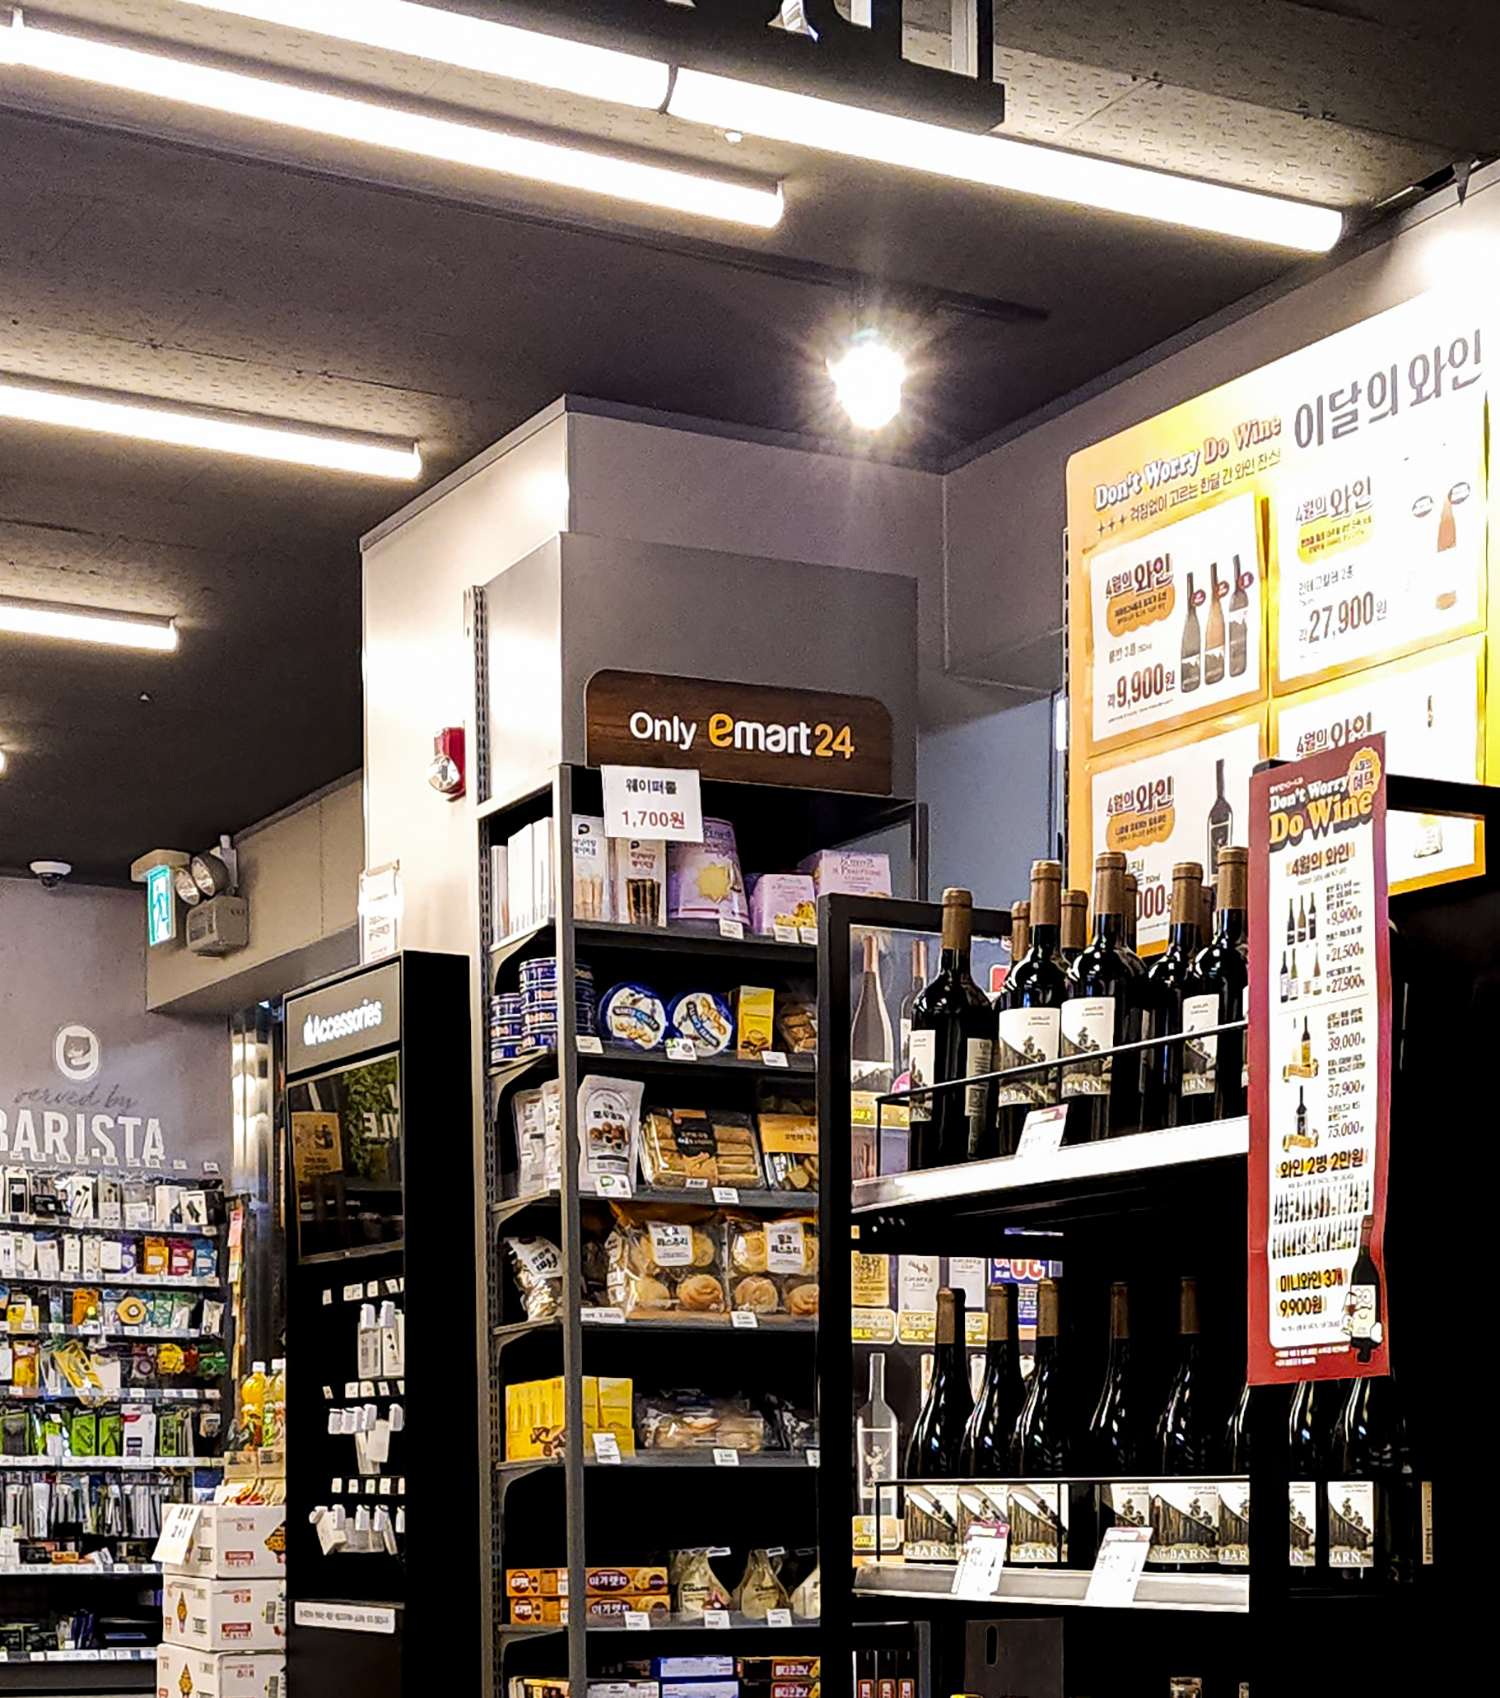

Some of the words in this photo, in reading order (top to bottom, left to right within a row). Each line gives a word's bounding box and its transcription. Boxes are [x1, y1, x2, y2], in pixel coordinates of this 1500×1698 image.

[1294, 364, 1398, 448] 이달의
[1408, 328, 1482, 406] 와인
[1094, 474, 1141, 511] Don't
[1144, 449, 1199, 487] Worry
[1203, 437, 1229, 464] Do
[1233, 416, 1281, 449] Wine
[1234, 459, 1255, 481] 와인
[1296, 491, 1328, 524] 4월의
[1329, 476, 1373, 518] 와인
[1106, 570, 1133, 595] 4월의
[1133, 553, 1174, 593] 와인
[1308, 591, 1387, 643] 27,900원
[1116, 662, 1175, 709] 9,900원
[630, 711, 698, 751] Only
[708, 714, 855, 760] emart24
[1297, 730, 1328, 756] 4월의
[625, 778, 677, 796] 웨이퍼롤
[1106, 793, 1134, 815] 4월의
[1135, 775, 1174, 813] 와인
[1268, 790, 1306, 812] Don't
[1307, 775, 1349, 801] Worry
[621, 810, 686, 830] 1,700원
[1269, 810, 1304, 845] Do
[1304, 791, 1373, 836] Wine
[1291, 851, 1323, 877] 4월의
[1325, 842, 1350, 866] 와인
[313, 999, 382, 1044] Accessories
[1280, 1158, 1305, 1178] 와인
[1307, 1154, 1328, 1175] 2병
[1330, 1149, 1363, 1171] 2만원
[1280, 1269, 1322, 1293] 미니와인
[1324, 1267, 1344, 1287] 3개
[1280, 1295, 1323, 1318] 9,900원
